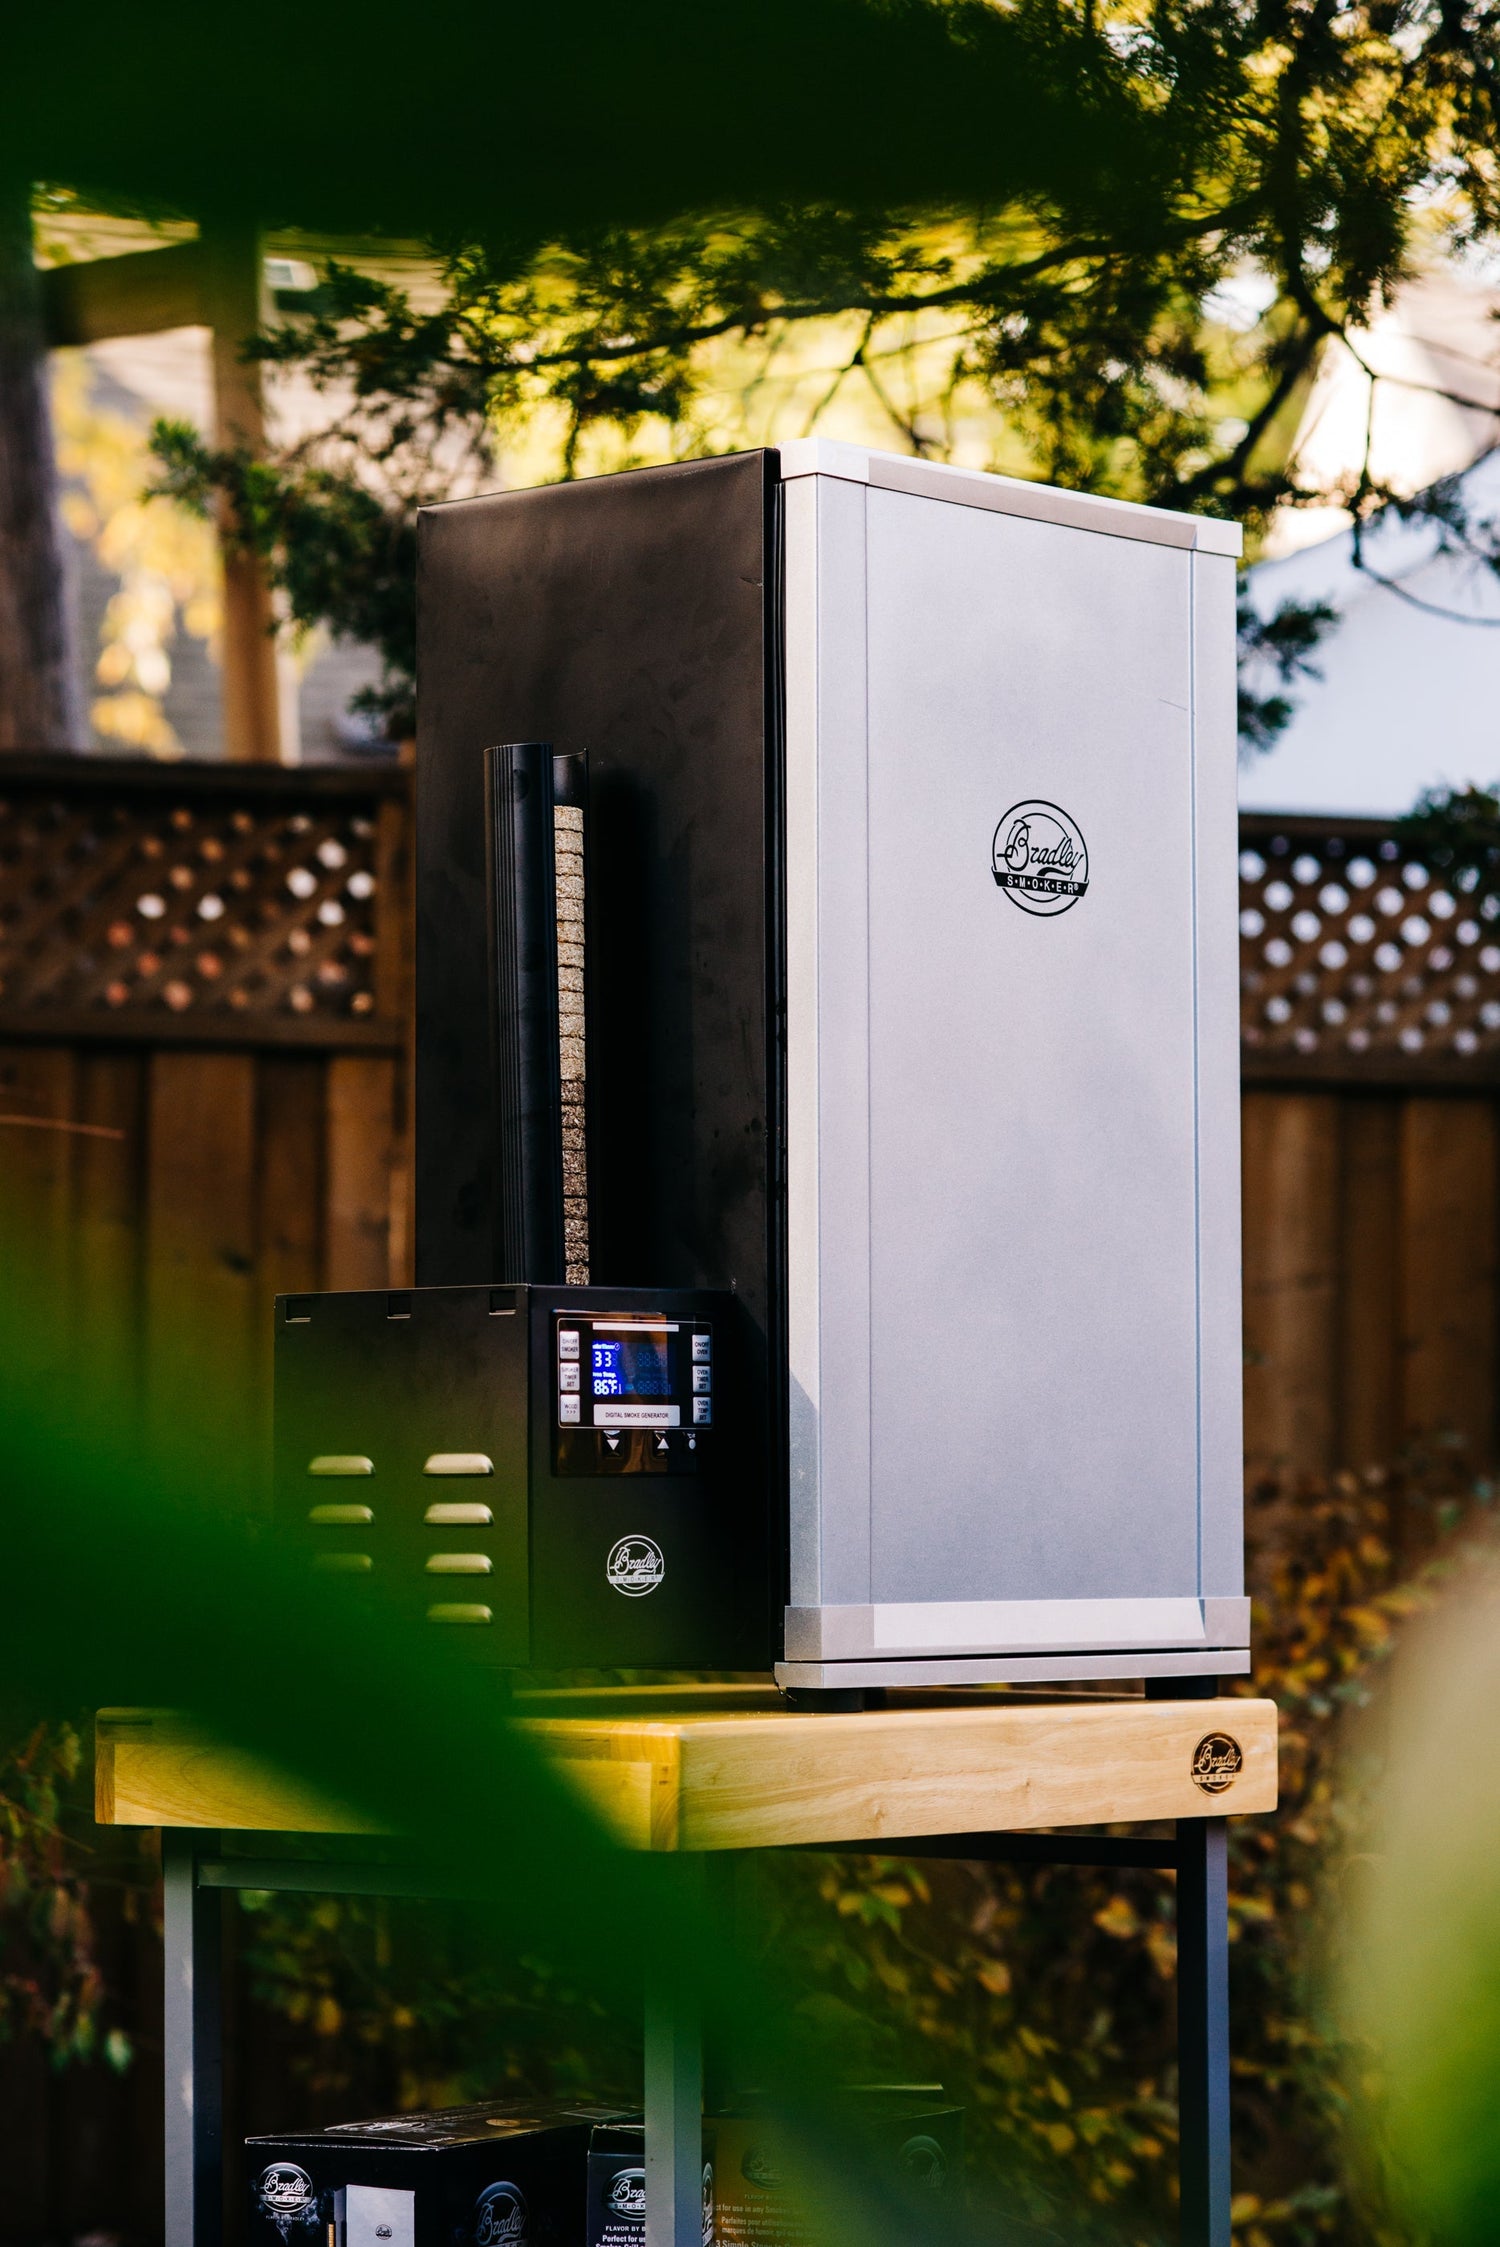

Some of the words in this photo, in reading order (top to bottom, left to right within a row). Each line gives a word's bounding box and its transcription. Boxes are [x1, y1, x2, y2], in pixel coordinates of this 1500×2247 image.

[997, 819, 1085, 877] Bradley
[610, 1547, 662, 1575] Bradley
[1194, 1743, 1241, 1774] Bradley
[260, 2171, 310, 2196] Bradley
[722, 2203, 731, 2211] for
[476, 2202, 527, 2245] Bradley
[602, 2234, 627, 2242] Perfect
[627, 2234, 638, 2242] for
